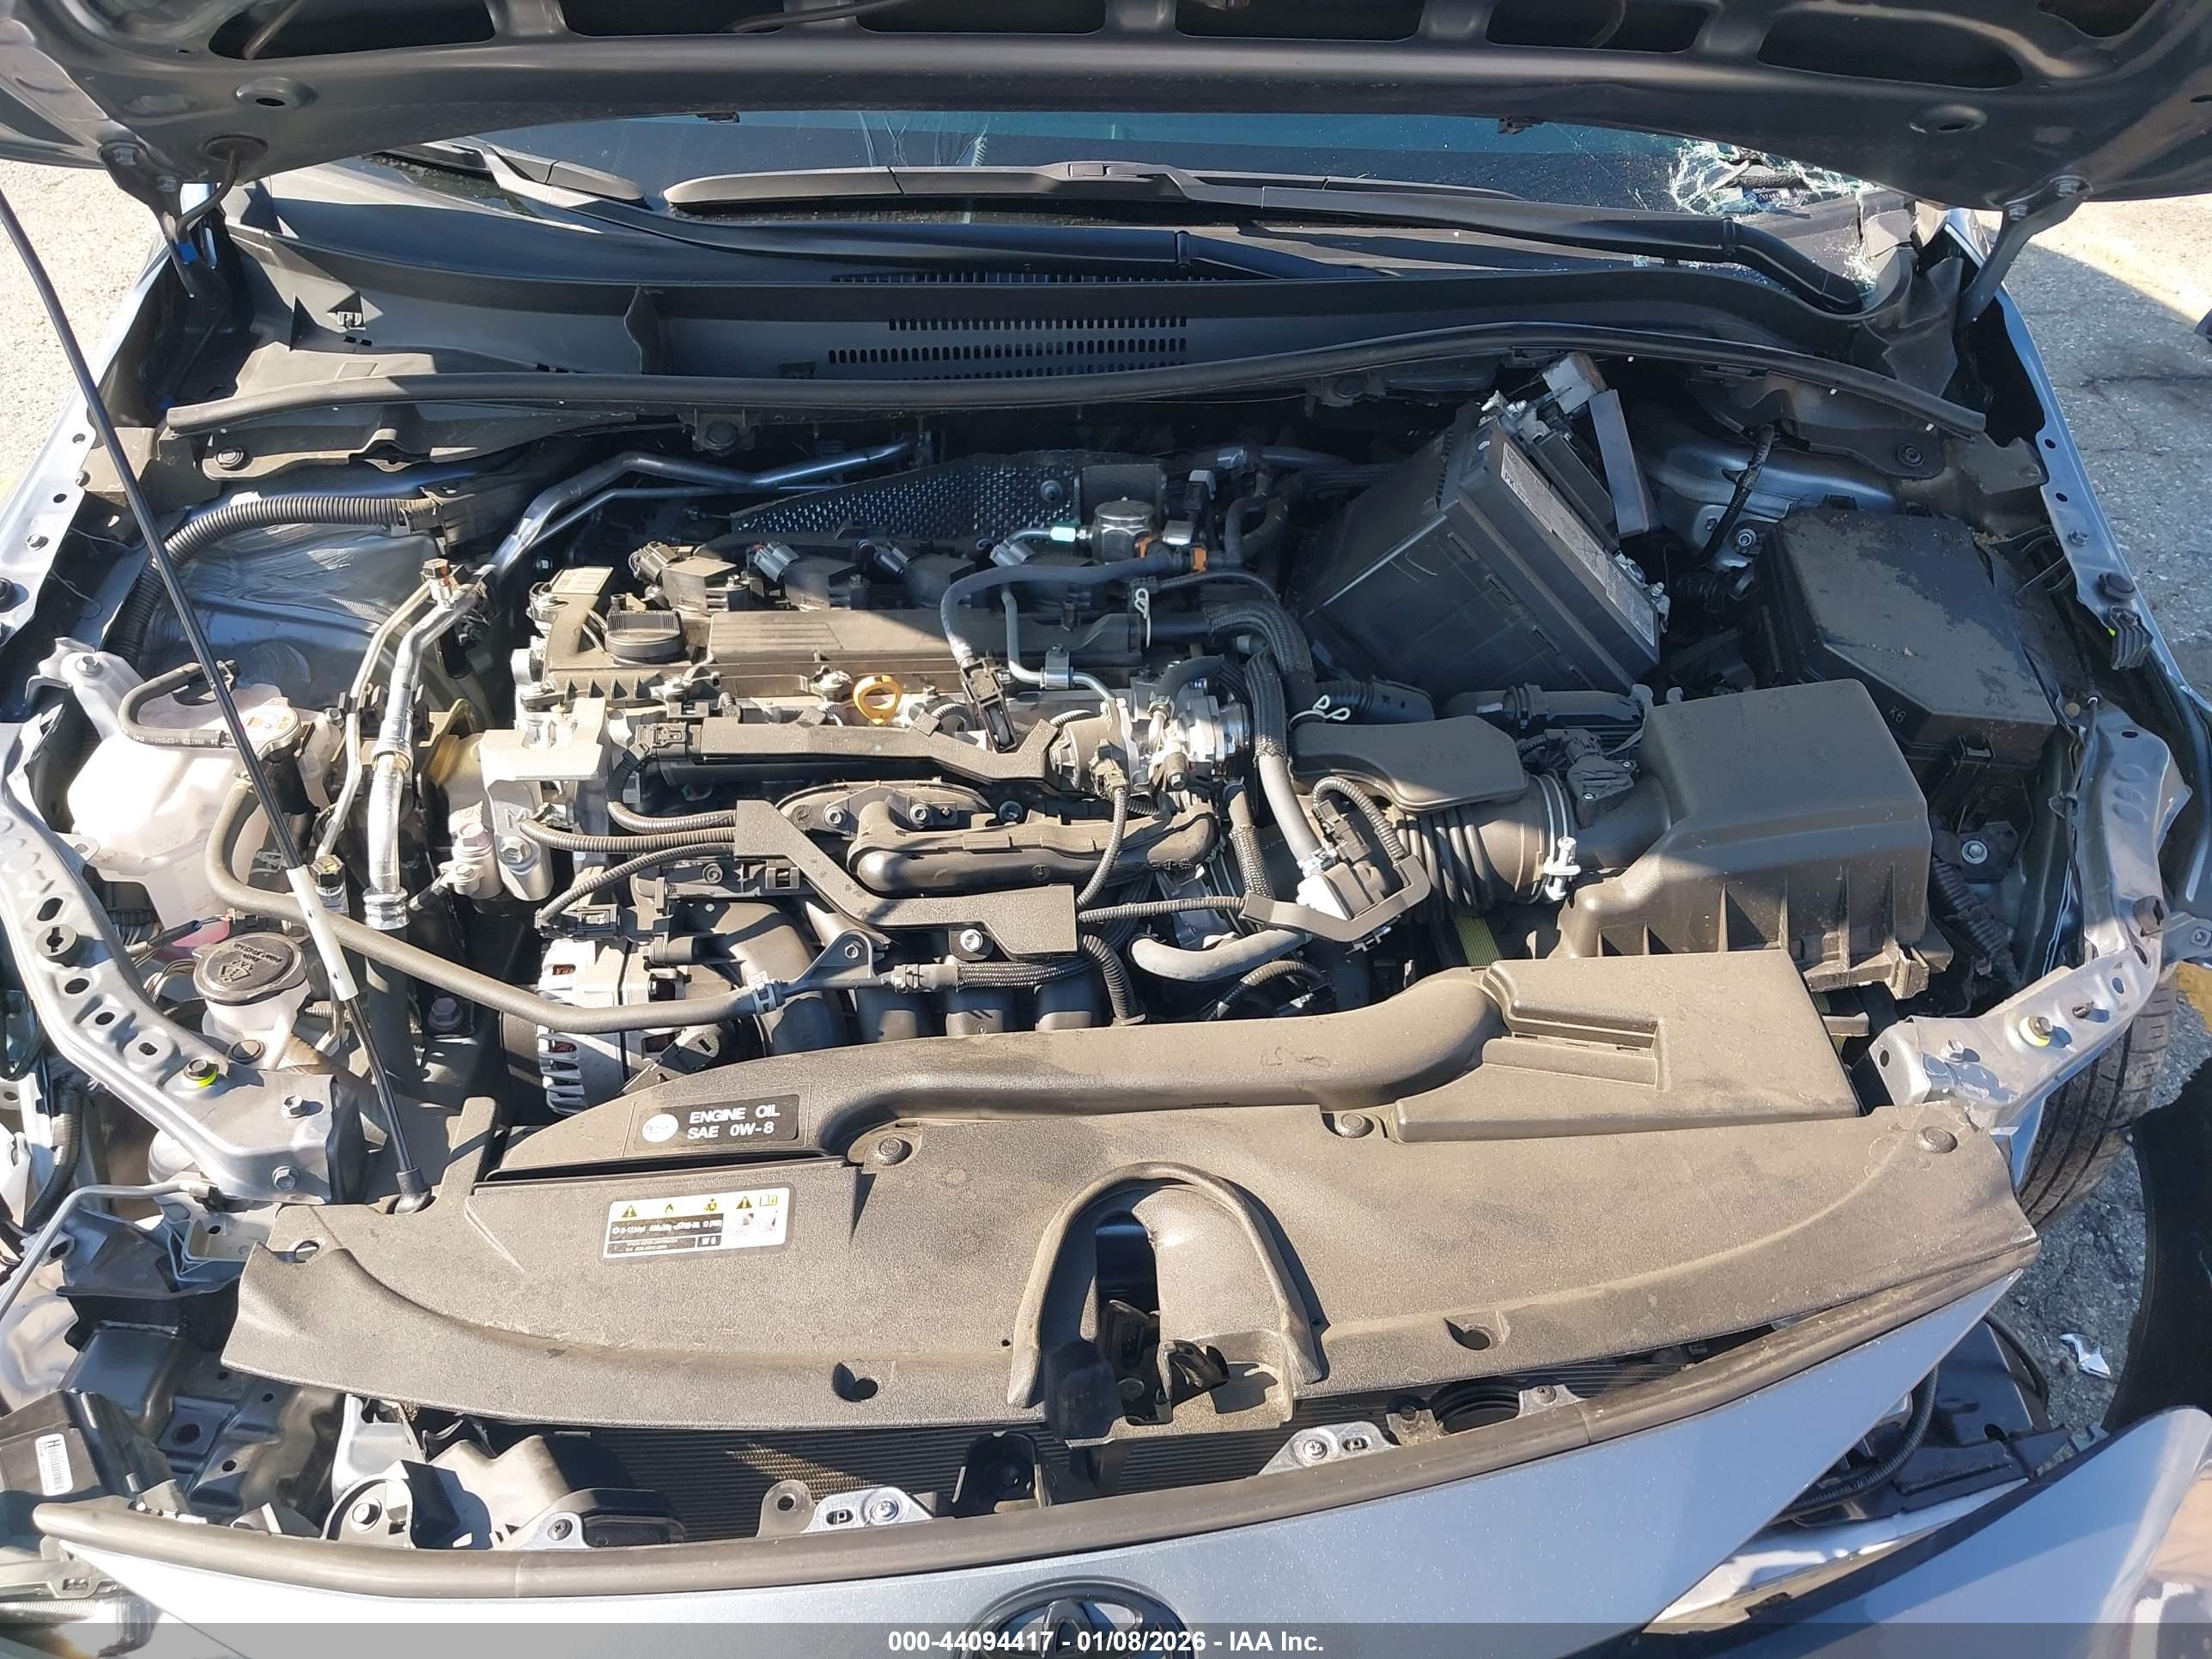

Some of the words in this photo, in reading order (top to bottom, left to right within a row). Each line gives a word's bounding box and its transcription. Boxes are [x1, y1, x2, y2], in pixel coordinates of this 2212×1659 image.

[689, 1107, 746, 1124] ENGINE
[755, 1103, 781, 1119] OIL
[686, 1125, 720, 1140] SAE
[729, 1121, 775, 1137] 0W-8
